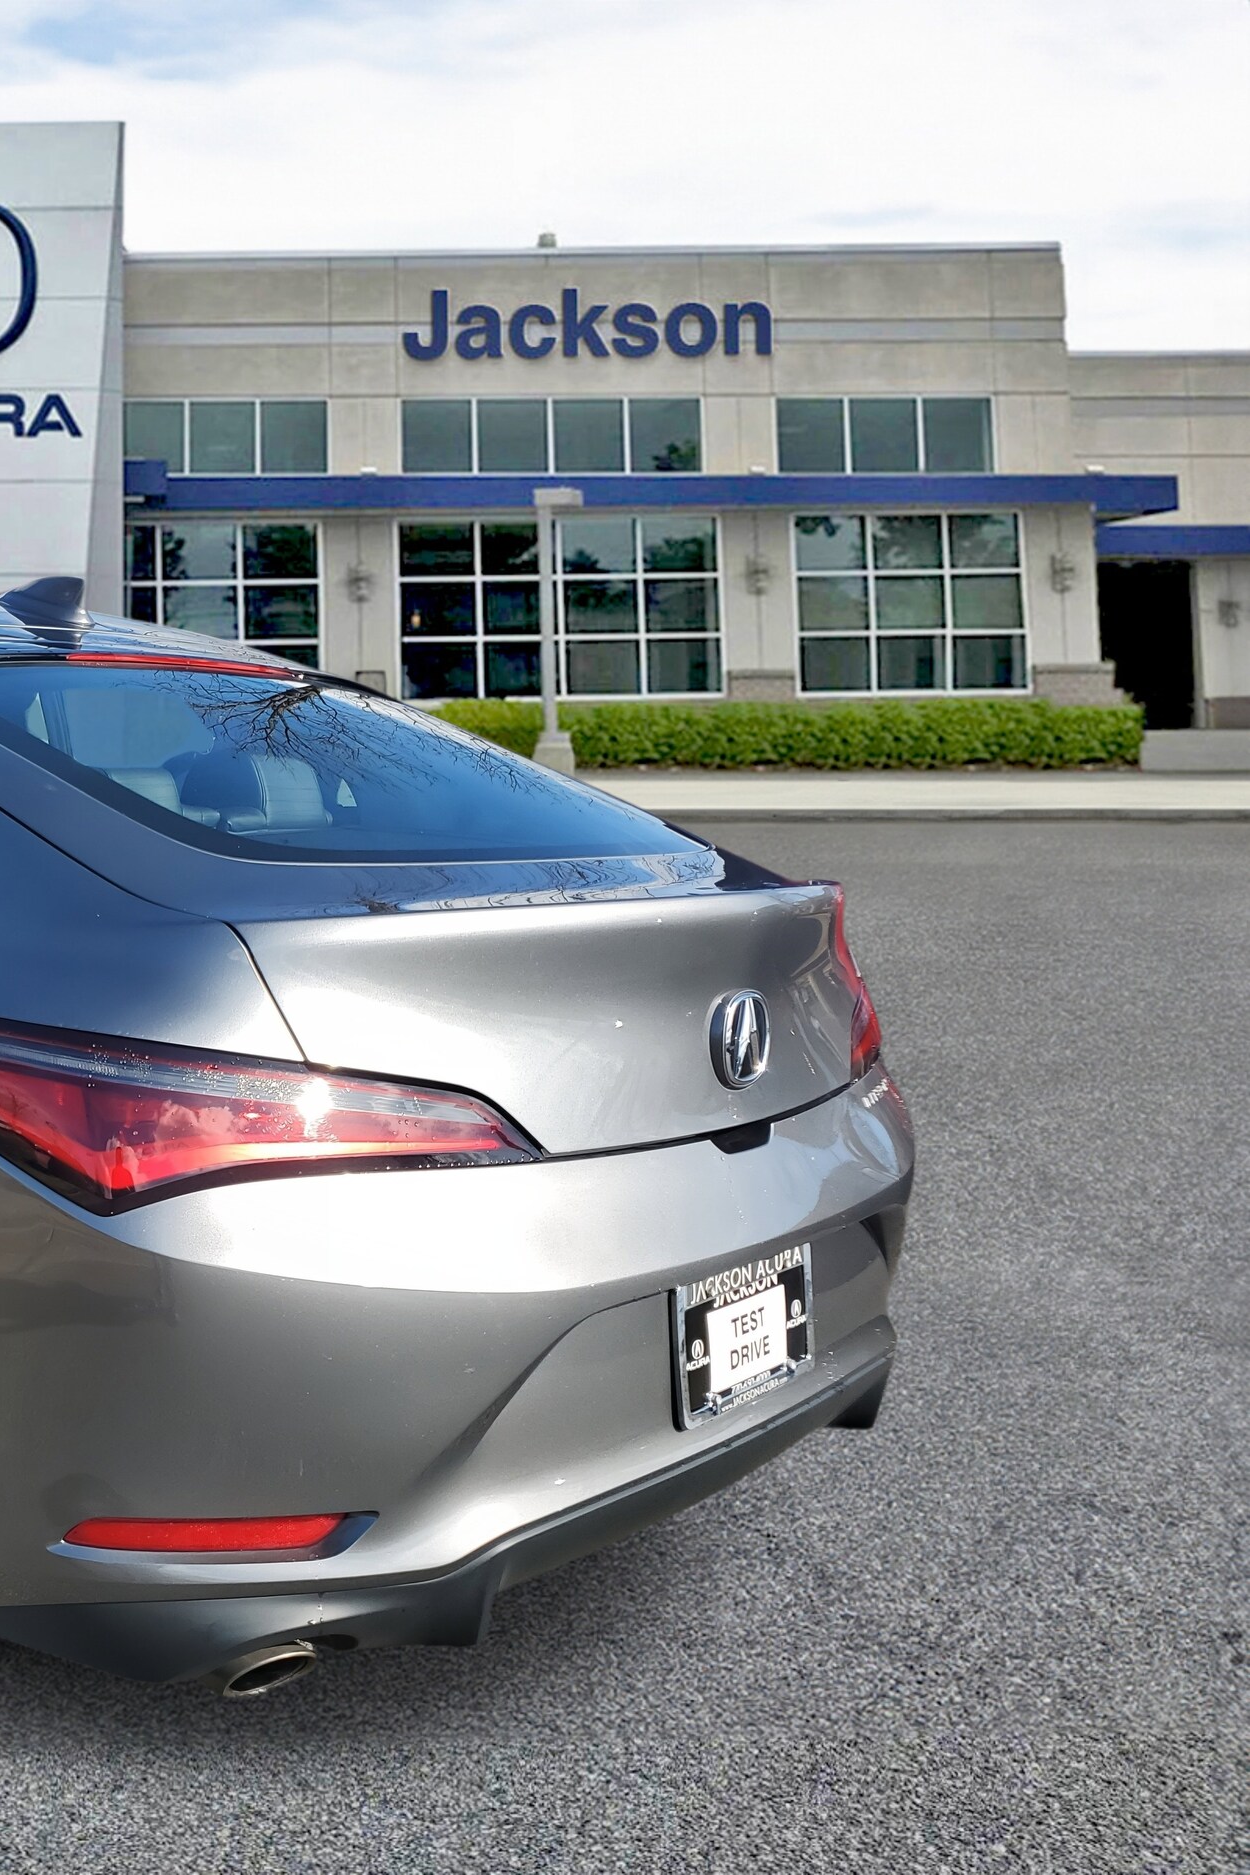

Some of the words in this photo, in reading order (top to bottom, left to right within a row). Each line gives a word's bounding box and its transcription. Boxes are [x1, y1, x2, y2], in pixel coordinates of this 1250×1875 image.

[402, 289, 772, 361] Jackson
[731, 1306, 765, 1338] TEST
[685, 1355, 711, 1371] ACURA
[730, 1334, 771, 1370] DRIVE
